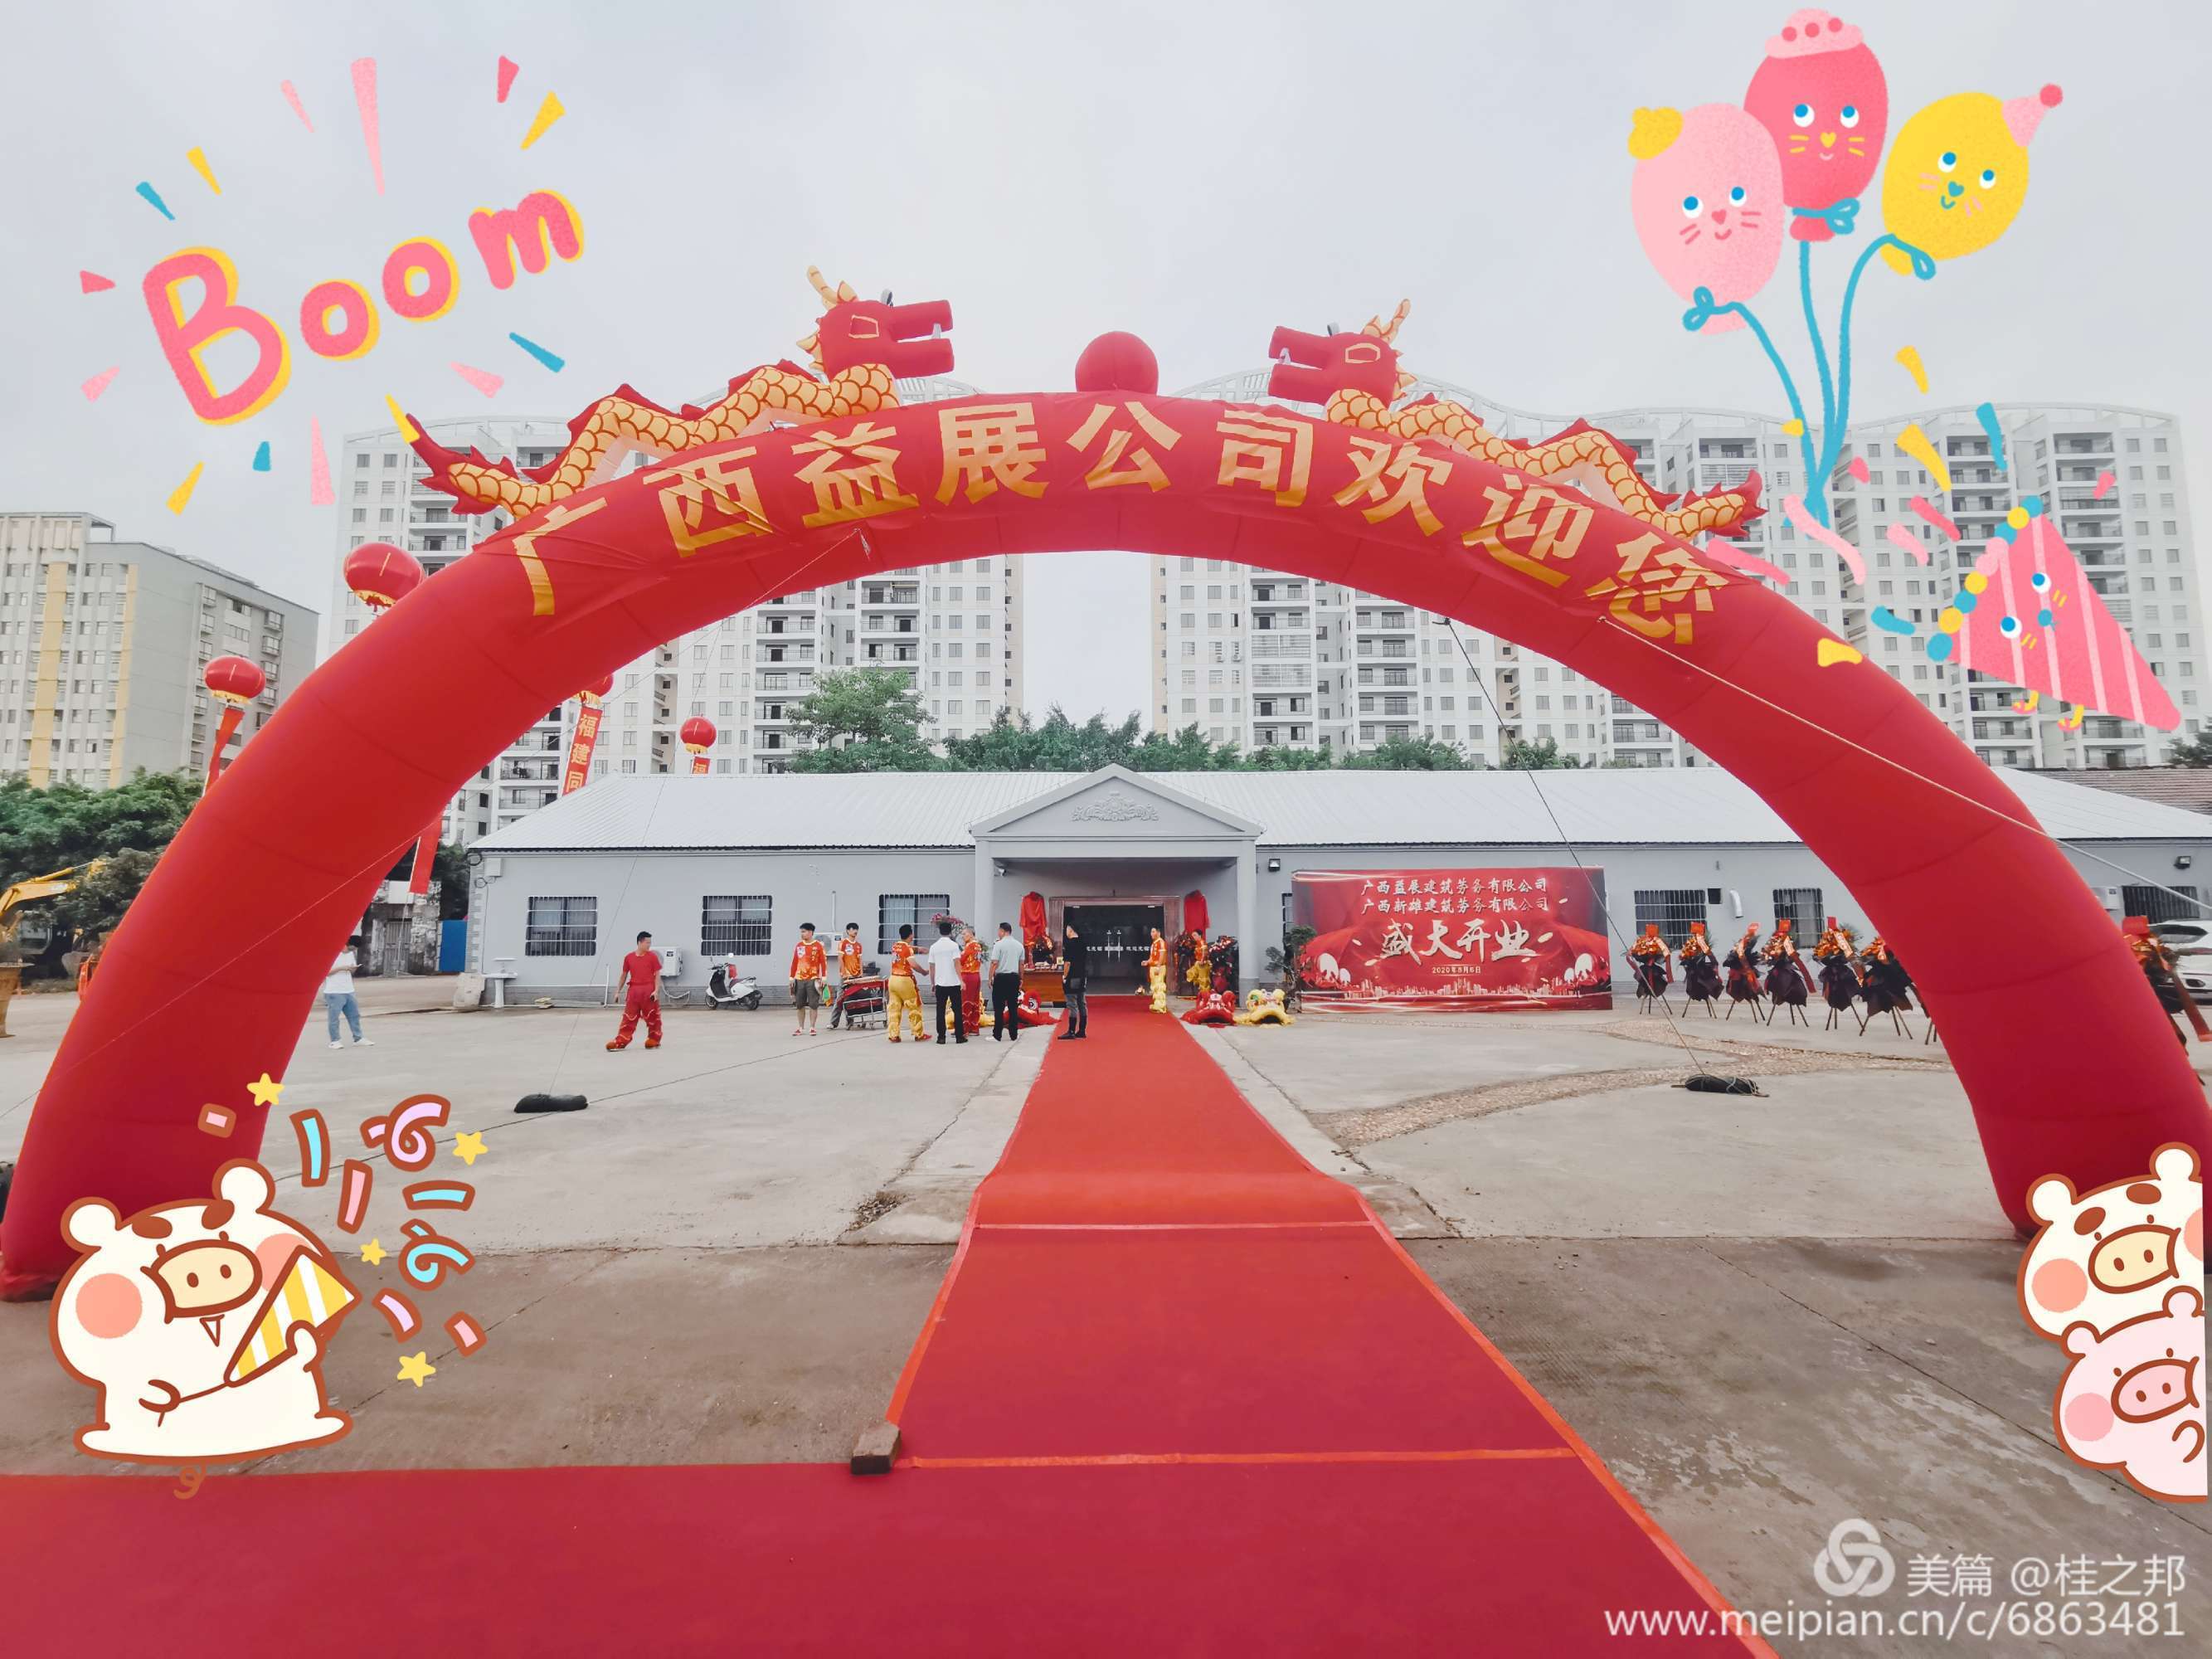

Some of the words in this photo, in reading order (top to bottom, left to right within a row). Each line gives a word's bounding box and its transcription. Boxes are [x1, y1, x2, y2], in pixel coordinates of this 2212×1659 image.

[512, 401, 1729, 645] 广西益展公司欢迎您
[1361, 878, 1548, 896] 广西益展建筑劳务有限公司
[1361, 897, 1549, 915] 广西新雄建筑劳务有限公司
[1380, 918, 1542, 966] 盛大开业
